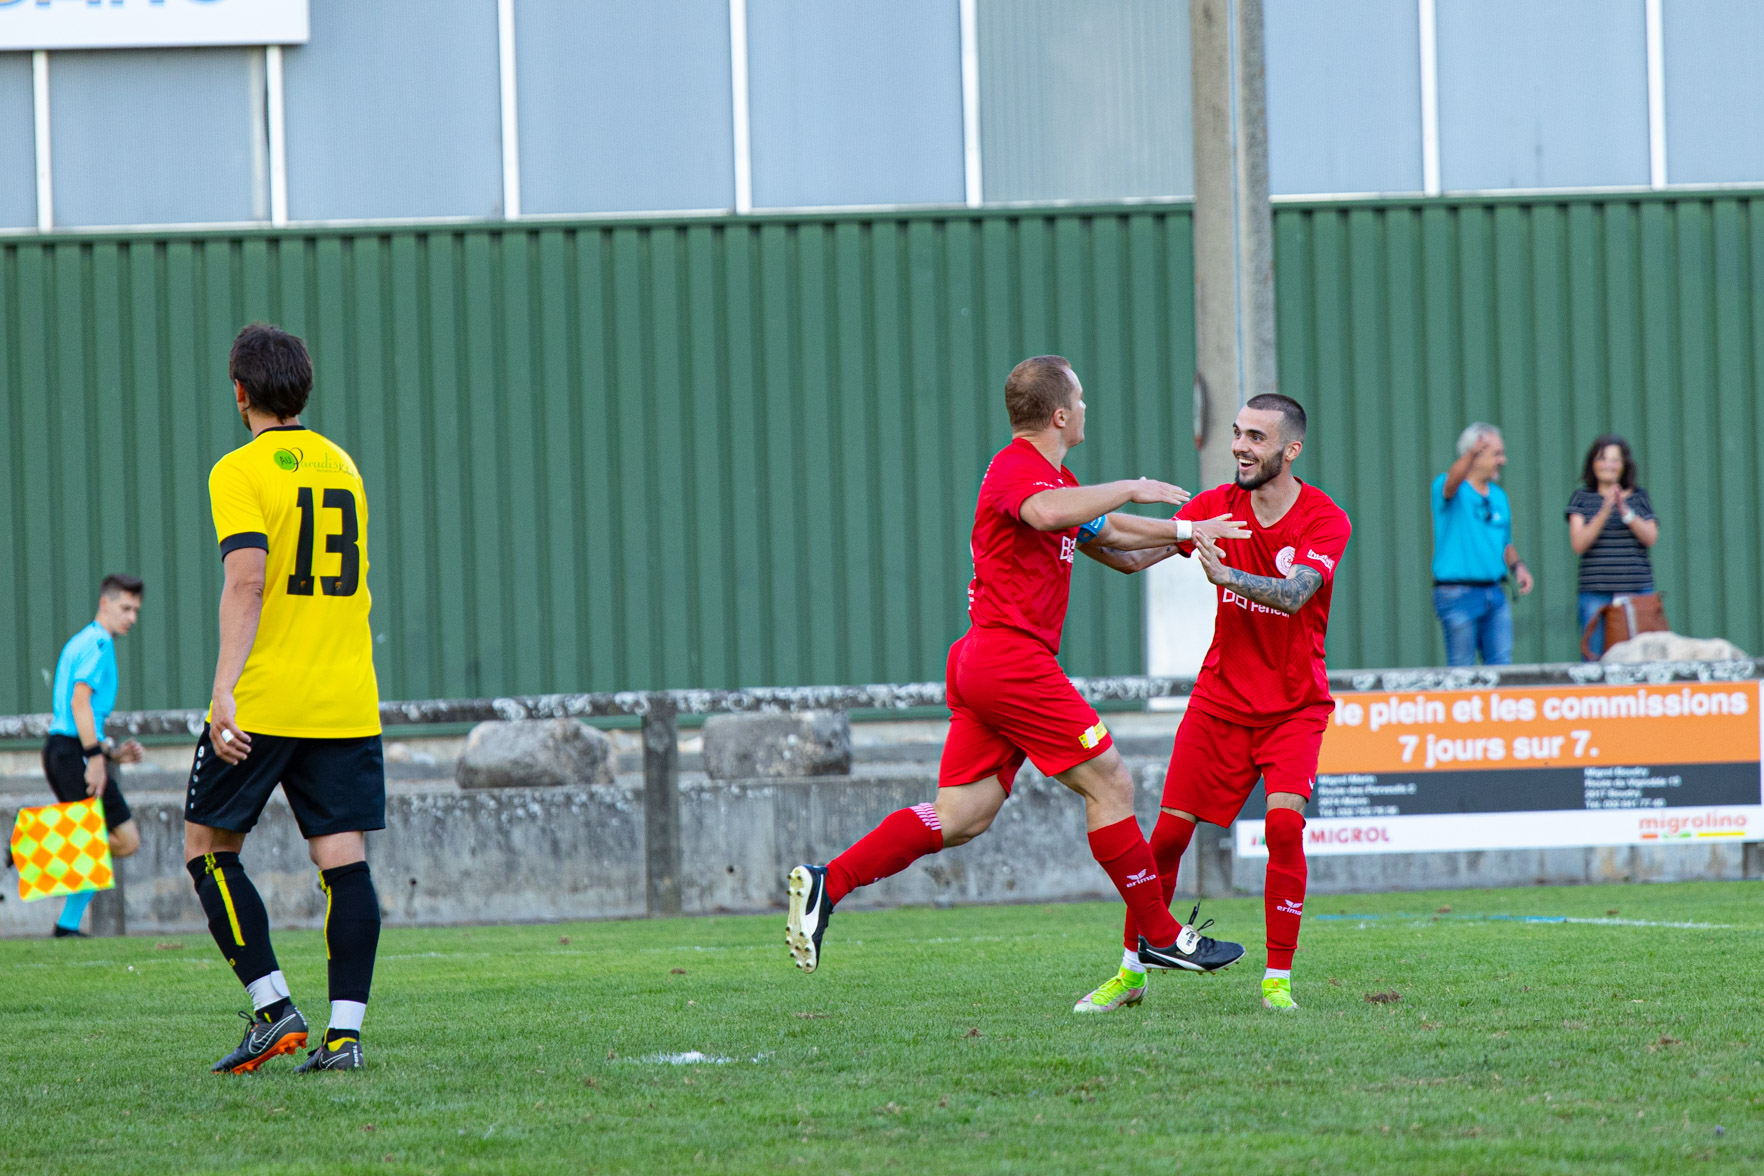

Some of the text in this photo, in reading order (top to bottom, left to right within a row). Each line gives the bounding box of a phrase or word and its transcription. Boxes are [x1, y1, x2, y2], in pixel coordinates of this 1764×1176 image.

[286, 486, 360, 597] 13
[1334, 687, 1749, 732] le plein et les commissions
[1398, 729, 1600, 769] 7 jours sur 7.
[1639, 809, 1747, 834] migrolino
[1310, 826, 1390, 844] MIGROL
[1126, 874, 1157, 888] erima
[1276, 905, 1302, 916] erima
